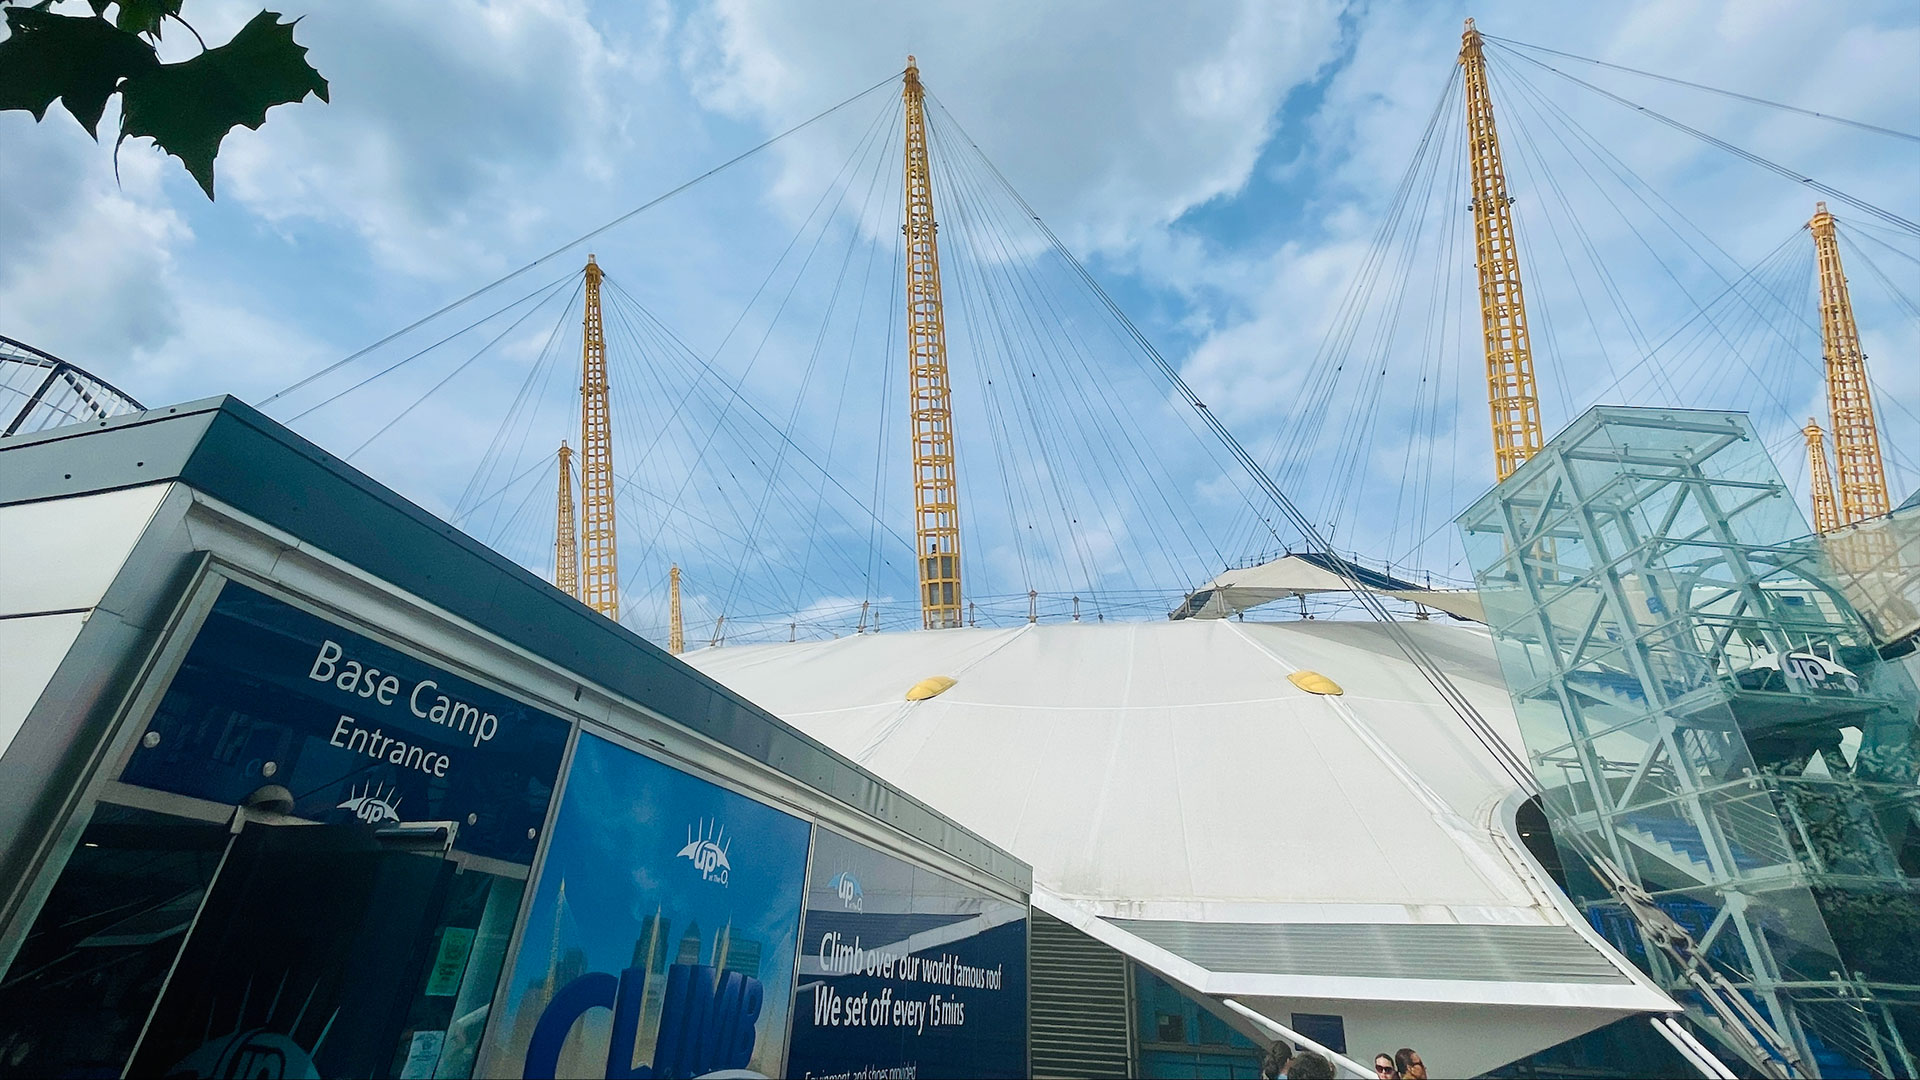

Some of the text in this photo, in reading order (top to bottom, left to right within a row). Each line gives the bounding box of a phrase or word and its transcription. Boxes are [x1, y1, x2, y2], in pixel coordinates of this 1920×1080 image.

[309, 640, 498, 747] Base Camp
[330, 715, 450, 777] Entrance
[819, 931, 1002, 990] Climb over our world famous roof
[814, 984, 965, 1036] We set off every 15 mins
